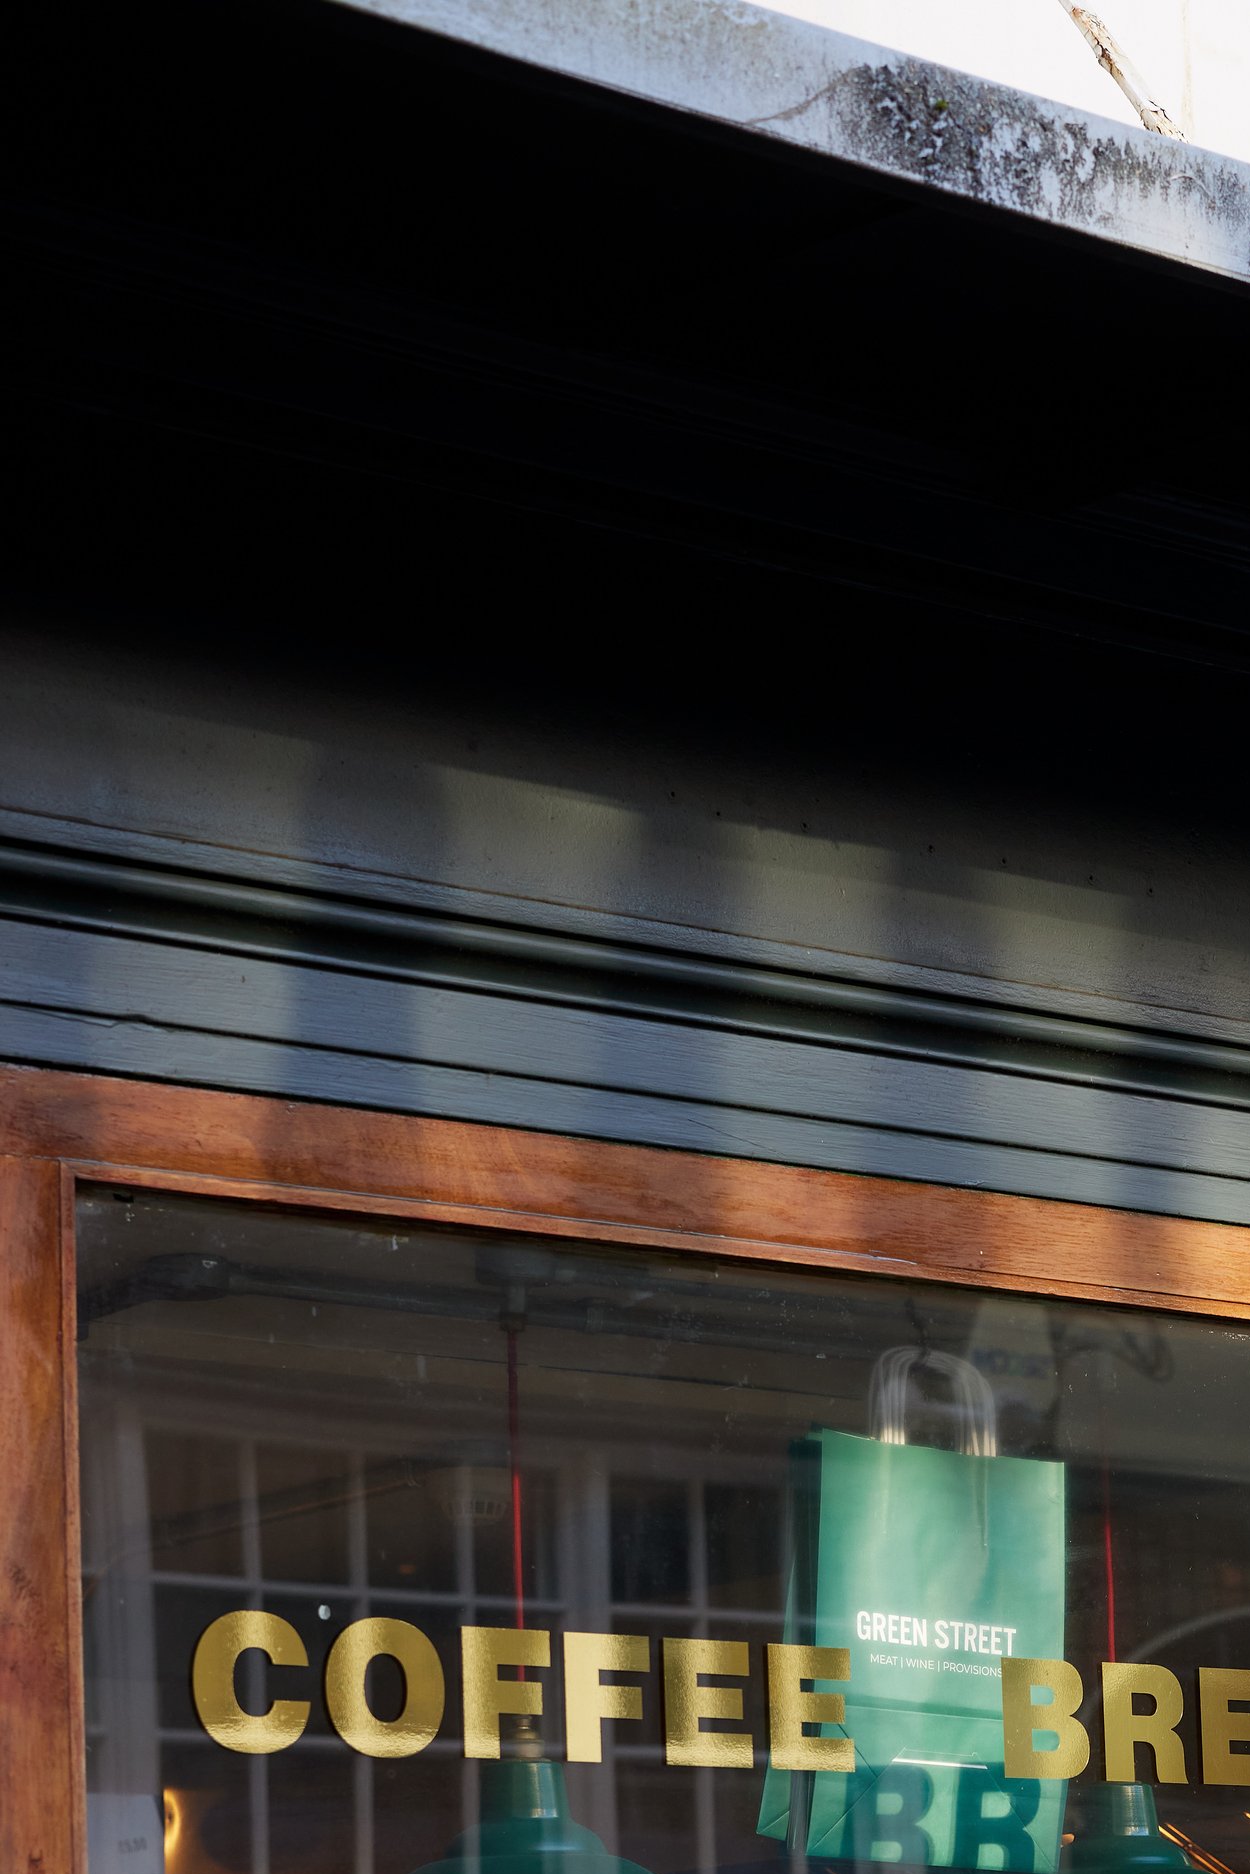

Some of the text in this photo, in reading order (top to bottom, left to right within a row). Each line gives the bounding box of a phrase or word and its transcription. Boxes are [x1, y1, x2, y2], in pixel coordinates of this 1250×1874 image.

[856, 1610, 1017, 1657] GREEN STREET
[870, 1653, 1002, 1678] MEAT WINE PROVISIONS
[192, 1610, 856, 1773] COFFEE
